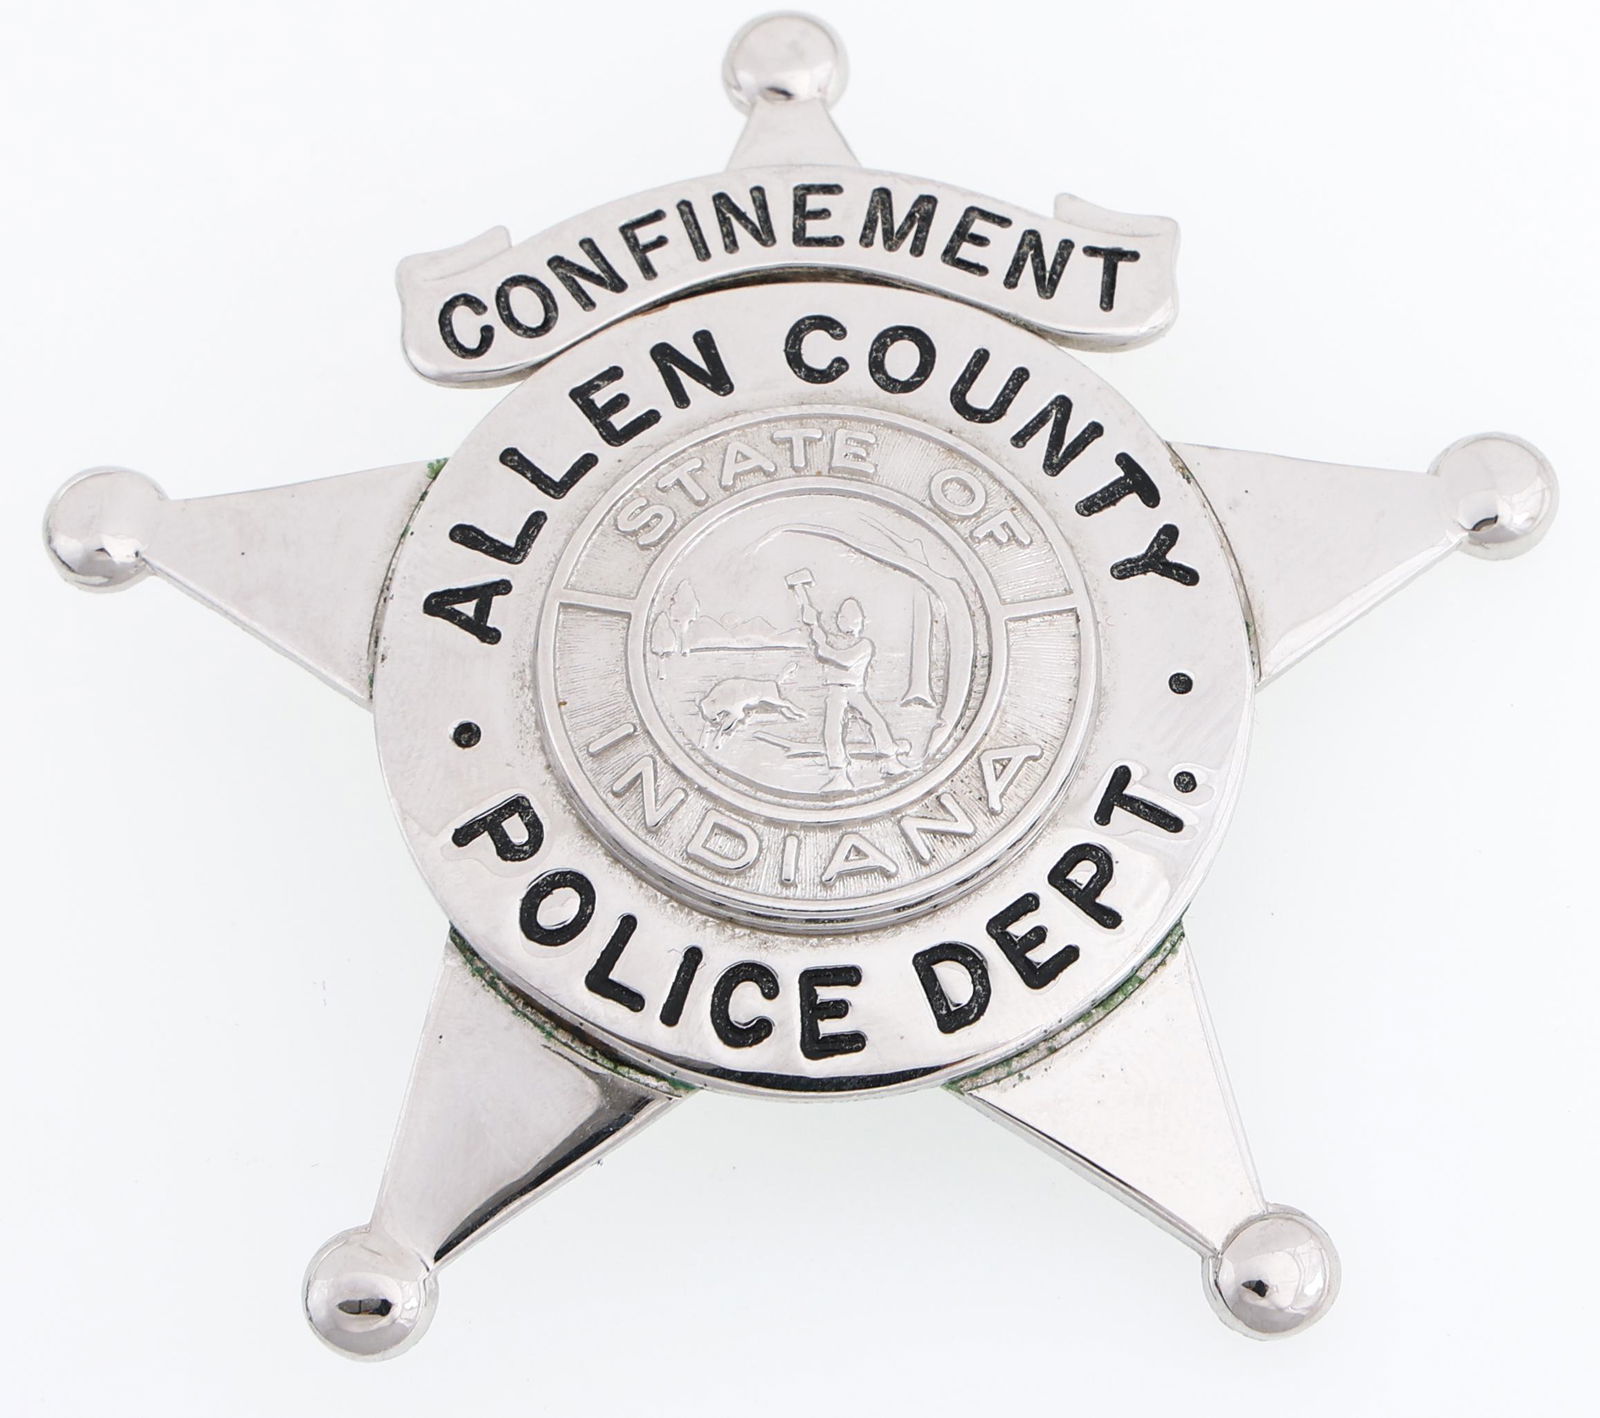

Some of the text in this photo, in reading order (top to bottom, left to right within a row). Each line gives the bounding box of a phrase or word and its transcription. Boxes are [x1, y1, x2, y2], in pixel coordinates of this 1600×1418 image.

[436, 183, 1141, 360] CONFINEMENT
[423, 314, 1201, 646] ALLEN COUNTY
[616, 428, 1031, 550] STATE OF
[588, 723, 1042, 886] INDIANA
[451, 764, 1198, 1061] POLICE DEPT.
